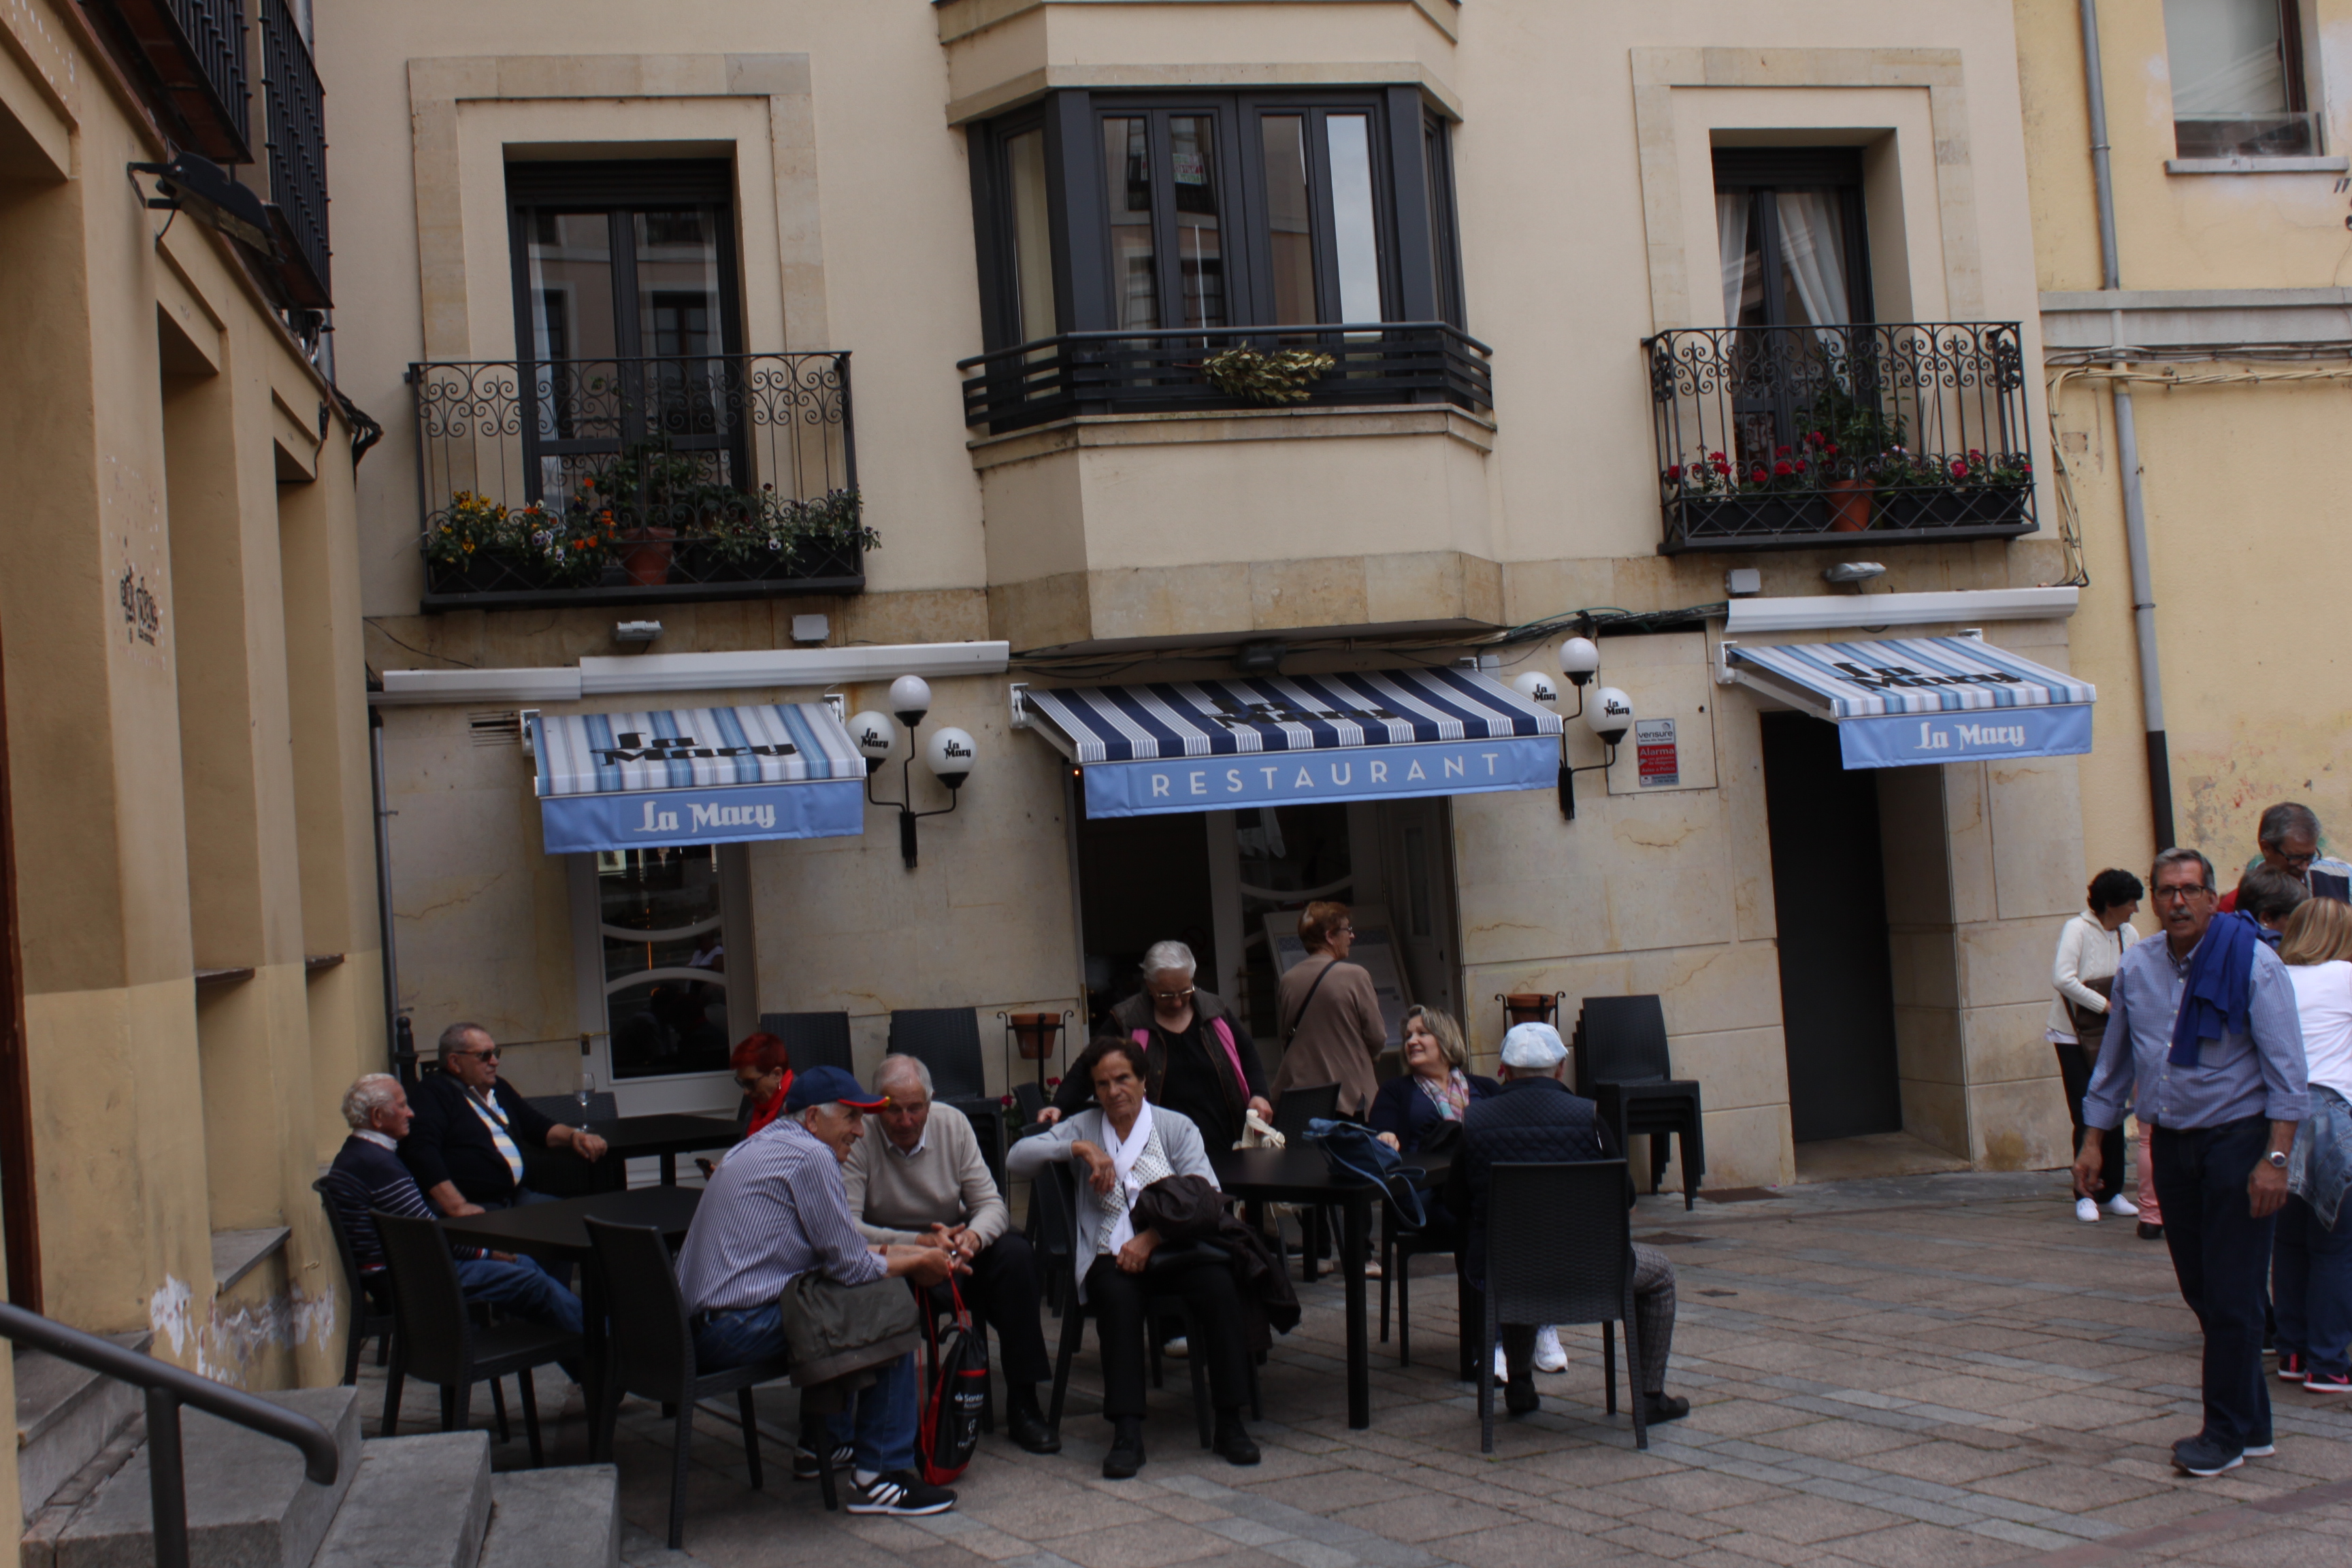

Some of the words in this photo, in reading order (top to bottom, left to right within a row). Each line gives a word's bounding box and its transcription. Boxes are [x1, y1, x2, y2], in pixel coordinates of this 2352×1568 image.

[1833, 662, 1922, 678] La
[1536, 683, 1548, 693] La
[1835, 672, 2023, 691] Mary
[1532, 691, 1556, 702] Mary
[1607, 698, 1619, 707] La
[1604, 706, 1630, 717] Mary
[1198, 708, 1400, 729] Mary
[865, 728, 878, 739] La
[1638, 730, 1673, 738] verisure
[1914, 721, 1950, 749] La
[1954, 723, 2026, 751] Mary
[616, 732, 700, 749] La
[861, 736, 889, 749] Mary
[947, 740, 960, 749] La
[589, 744, 800, 766] Mary
[944, 747, 971, 760] Mary
[1639, 747, 1674, 755] Alarma
[1152, 753, 1499, 798] RESTAURANT
[634, 800, 679, 832] La
[687, 802, 777, 833] Mary
